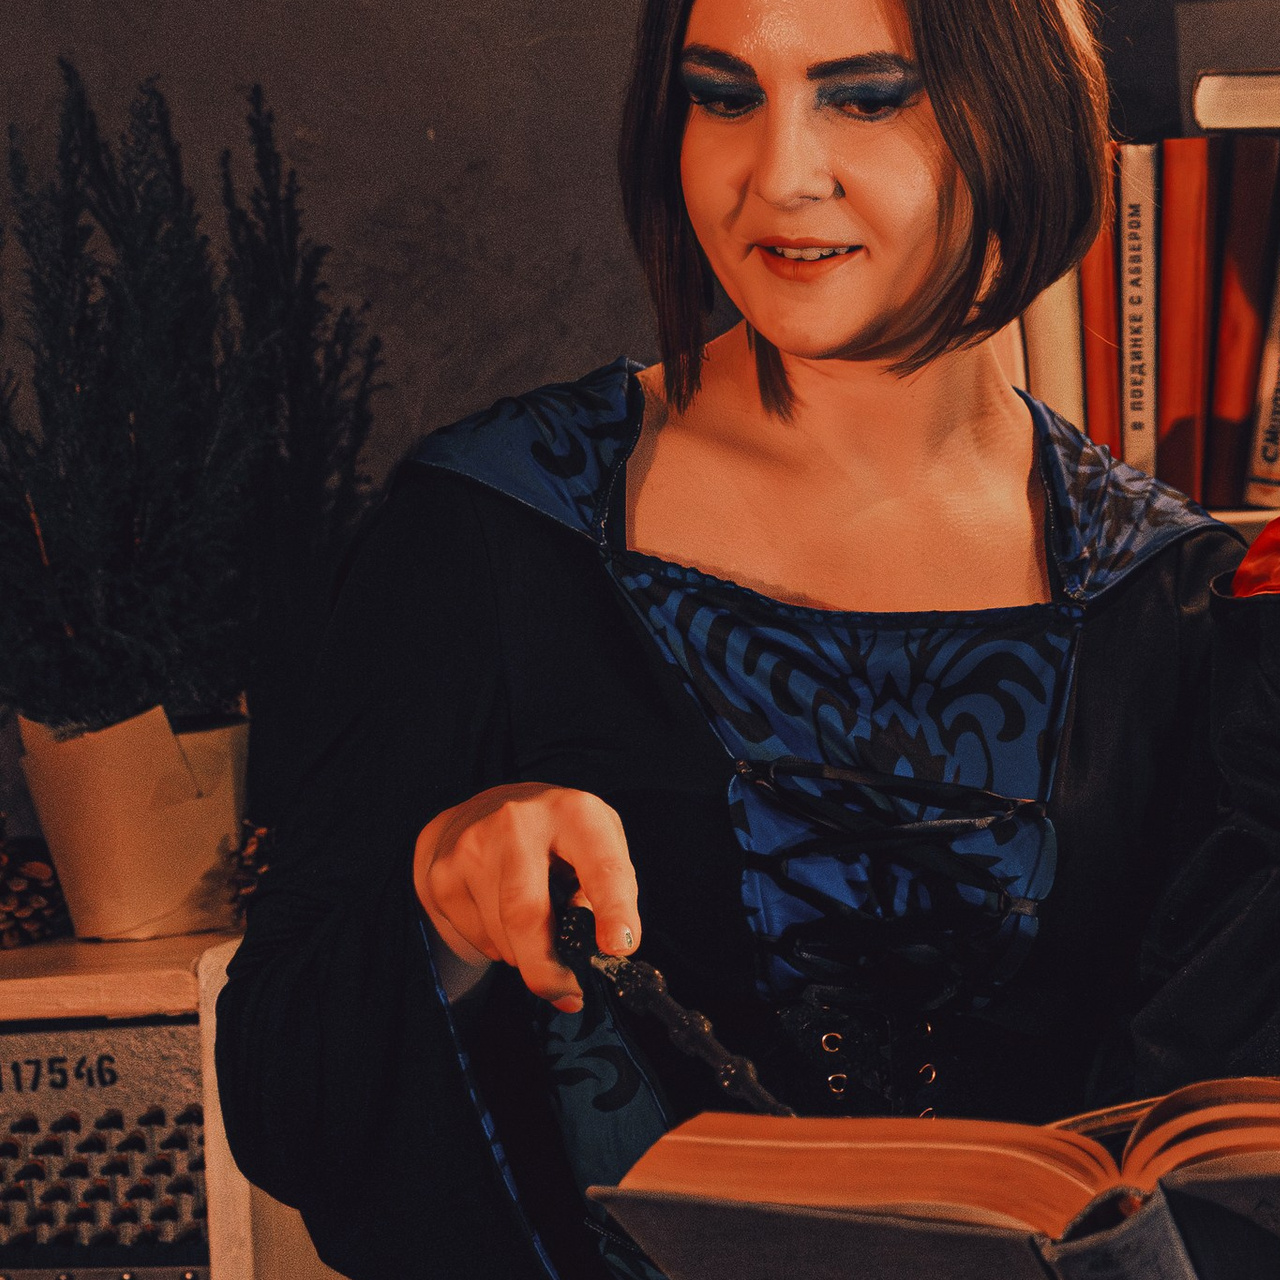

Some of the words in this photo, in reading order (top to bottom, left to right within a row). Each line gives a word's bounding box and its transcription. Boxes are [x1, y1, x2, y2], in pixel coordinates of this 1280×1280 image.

[1127, 202, 1142, 287] АБВЕРОМ
[1130, 293, 1143, 305] С
[1129, 314, 1144, 413] ПОЕДИНКЕ
[1131, 421, 1143, 431] В
[0, 1053, 119, 1093] 17546
